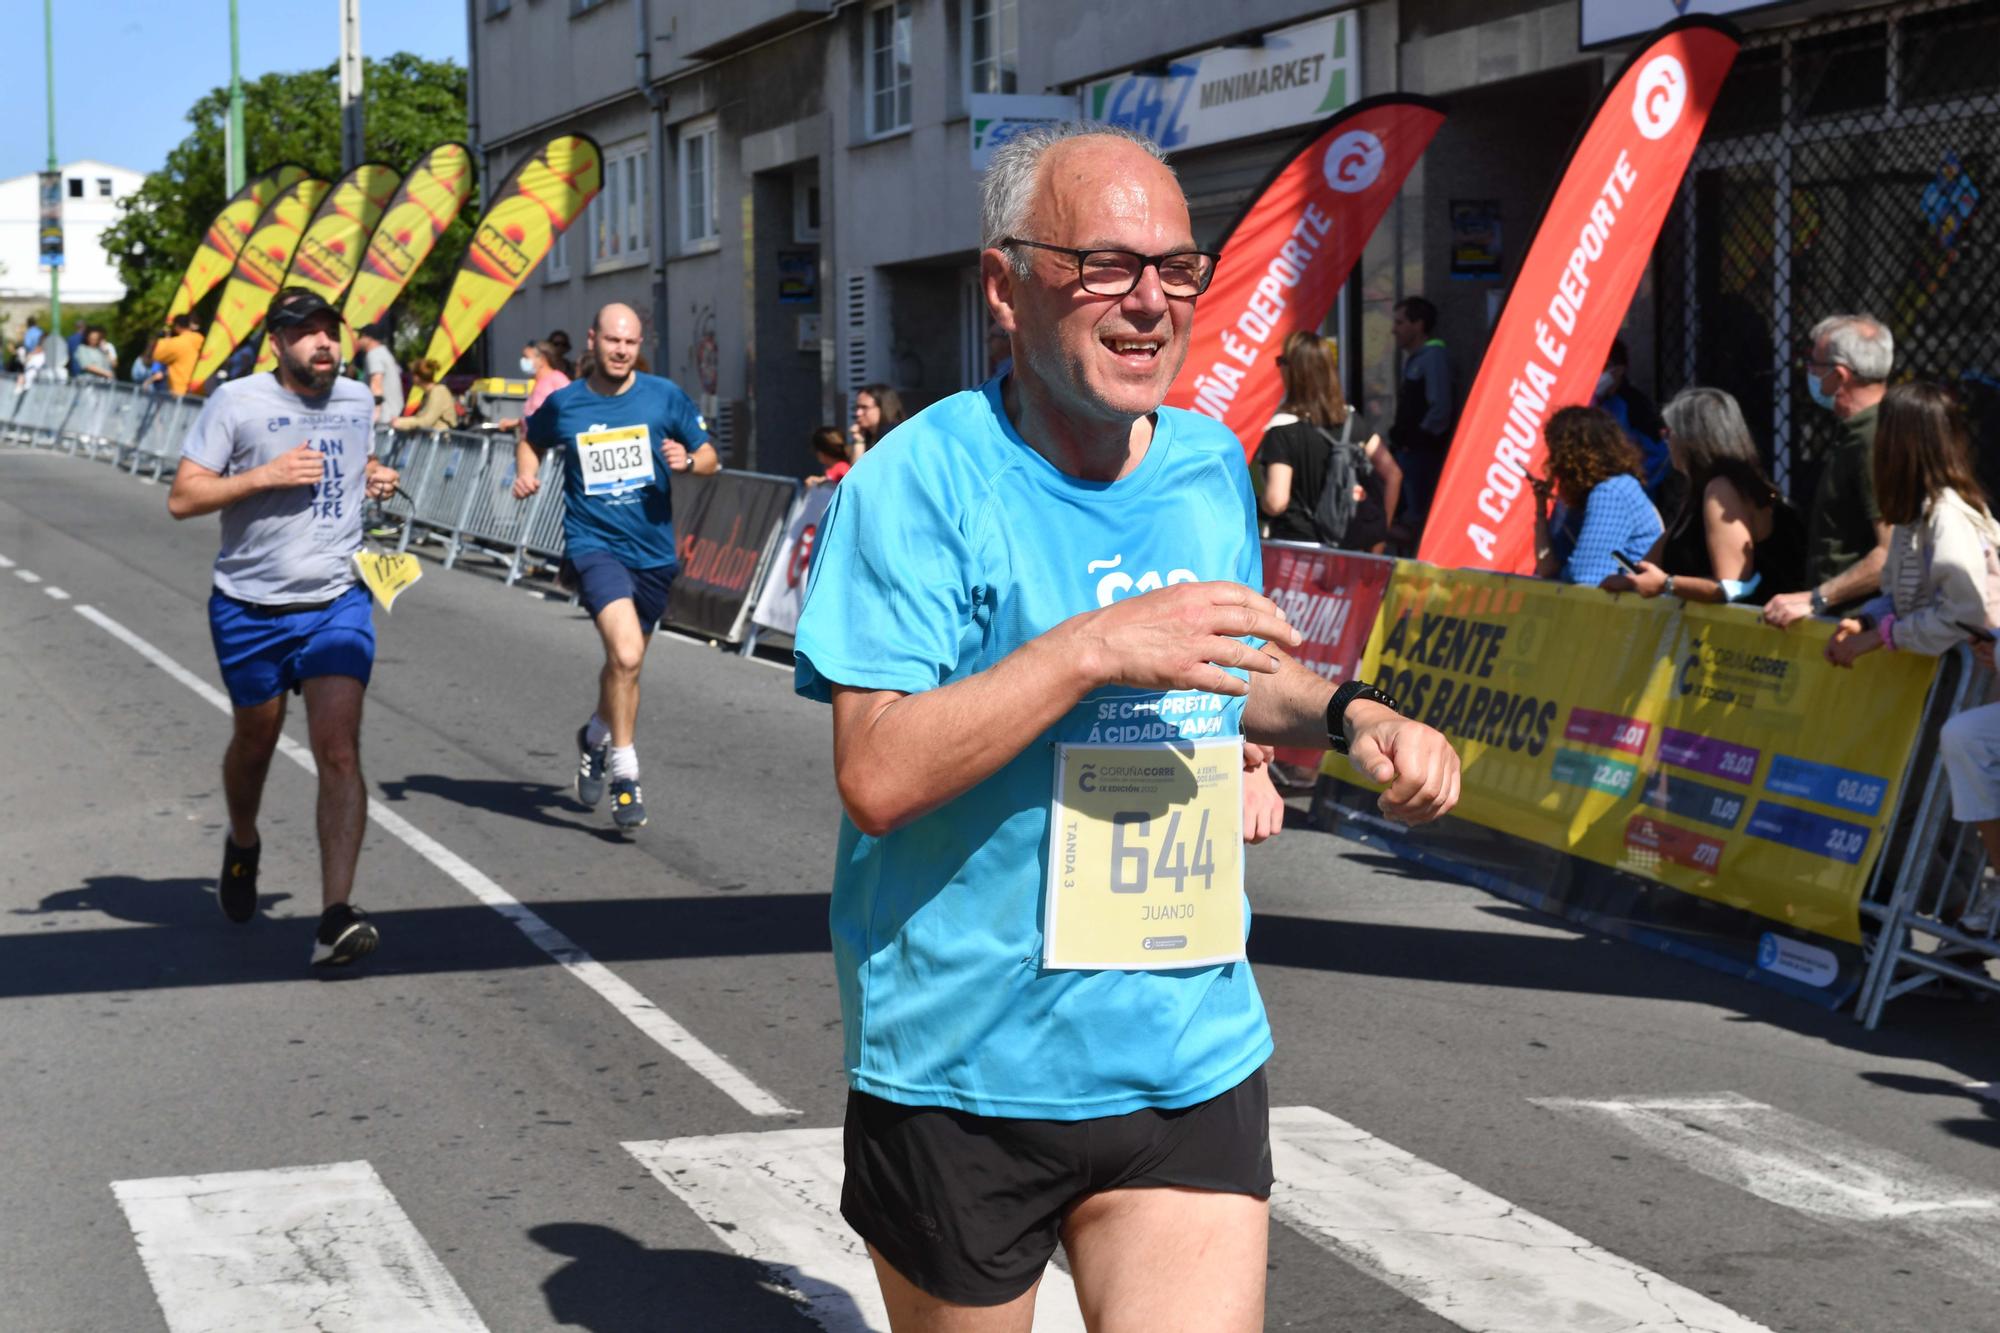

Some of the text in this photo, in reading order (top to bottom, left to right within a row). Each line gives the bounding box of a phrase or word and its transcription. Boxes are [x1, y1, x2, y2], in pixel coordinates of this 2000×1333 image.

[1200, 54, 1325, 109] MINIMARKET
[1237, 202, 1334, 343] DEPORTE
[1220, 329, 1259, 367] É
[1467, 149, 1637, 560] A CORUÑA É DEPORTE
[588, 445, 643, 473] 3033
[311, 502, 344, 519] TRE
[1380, 608, 1508, 679] A XENTE
[1098, 703, 1117, 719] SE
[1119, 701, 1160, 719] CHE
[1423, 677, 1557, 757] BARRIOS
[1086, 722, 1102, 743] Á
[1104, 723, 1177, 743] CIDADE
[1100, 766, 1175, 777] CORUÑACORRE
[1108, 784, 1140, 793] EDICIÓN
[1064, 822, 1077, 889] TANDA 3
[1111, 808, 1215, 893] 644
[1142, 904, 1194, 920] JUANJO
